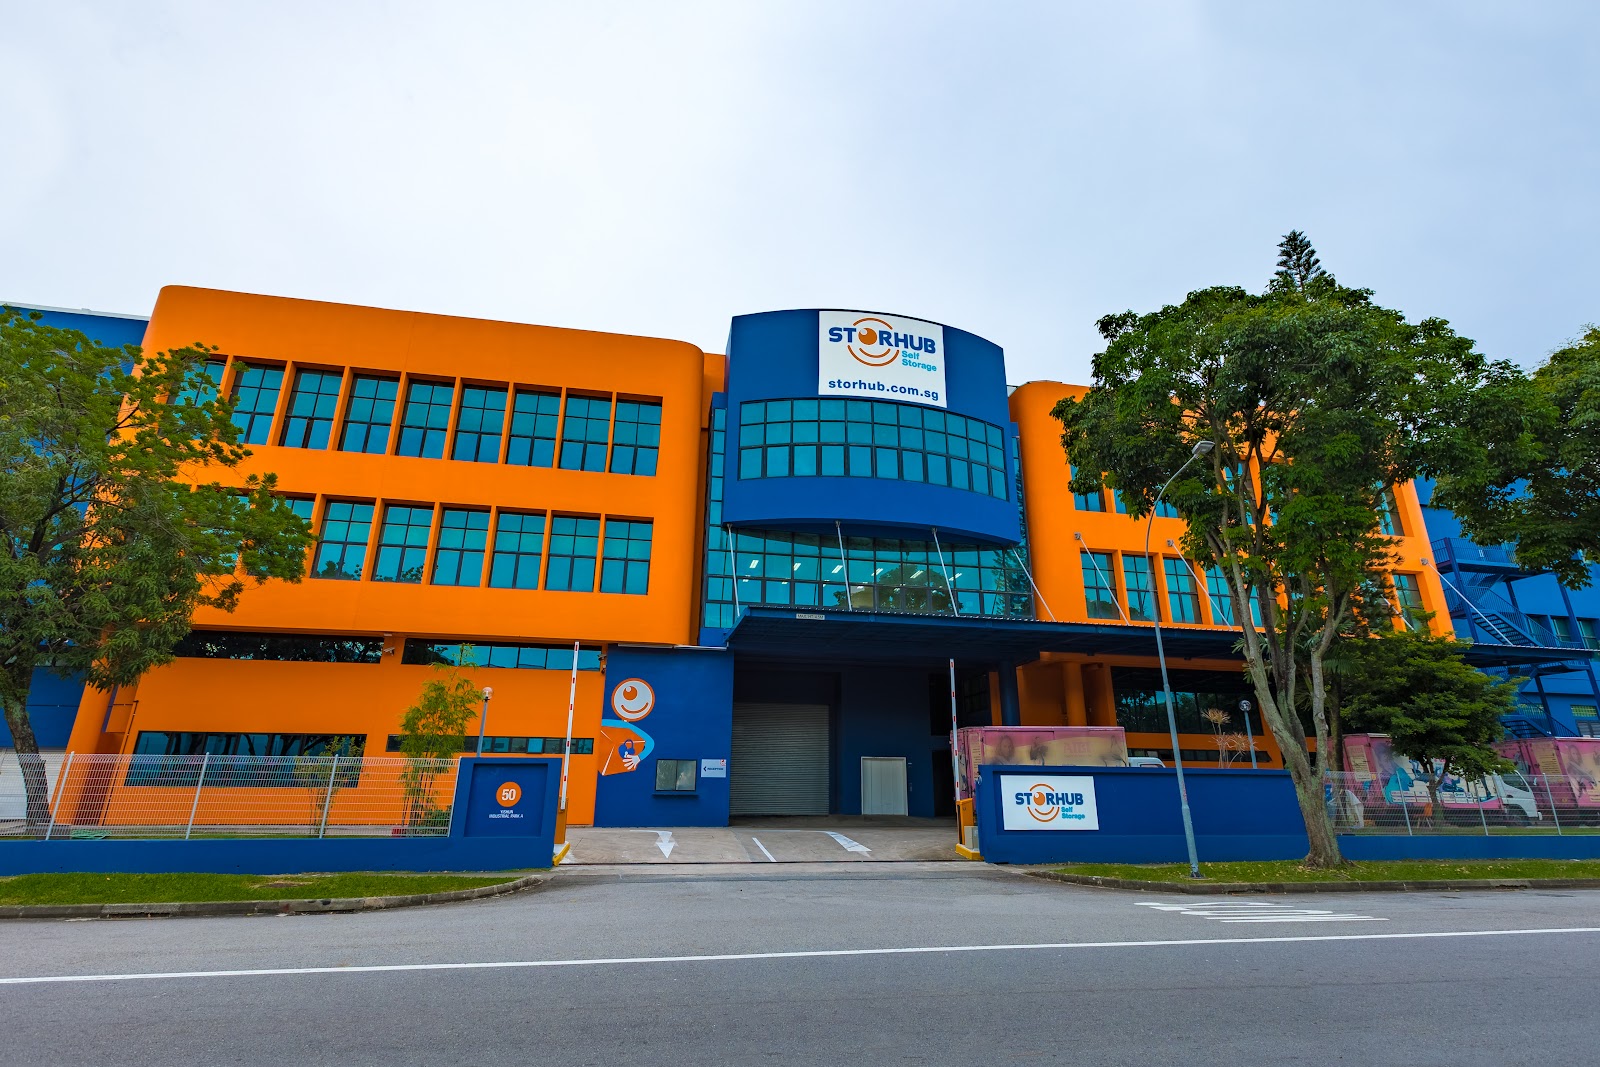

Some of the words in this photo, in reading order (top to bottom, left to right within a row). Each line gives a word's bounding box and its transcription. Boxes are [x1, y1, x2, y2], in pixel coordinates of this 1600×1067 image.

[828, 327, 936, 354] STORHUB
[901, 350, 920, 360] Self
[901, 359, 937, 372] Storage
[828, 379, 939, 401] storhub.com.sg
[502, 788, 516, 800] 50
[1015, 792, 1084, 806] STORHUB
